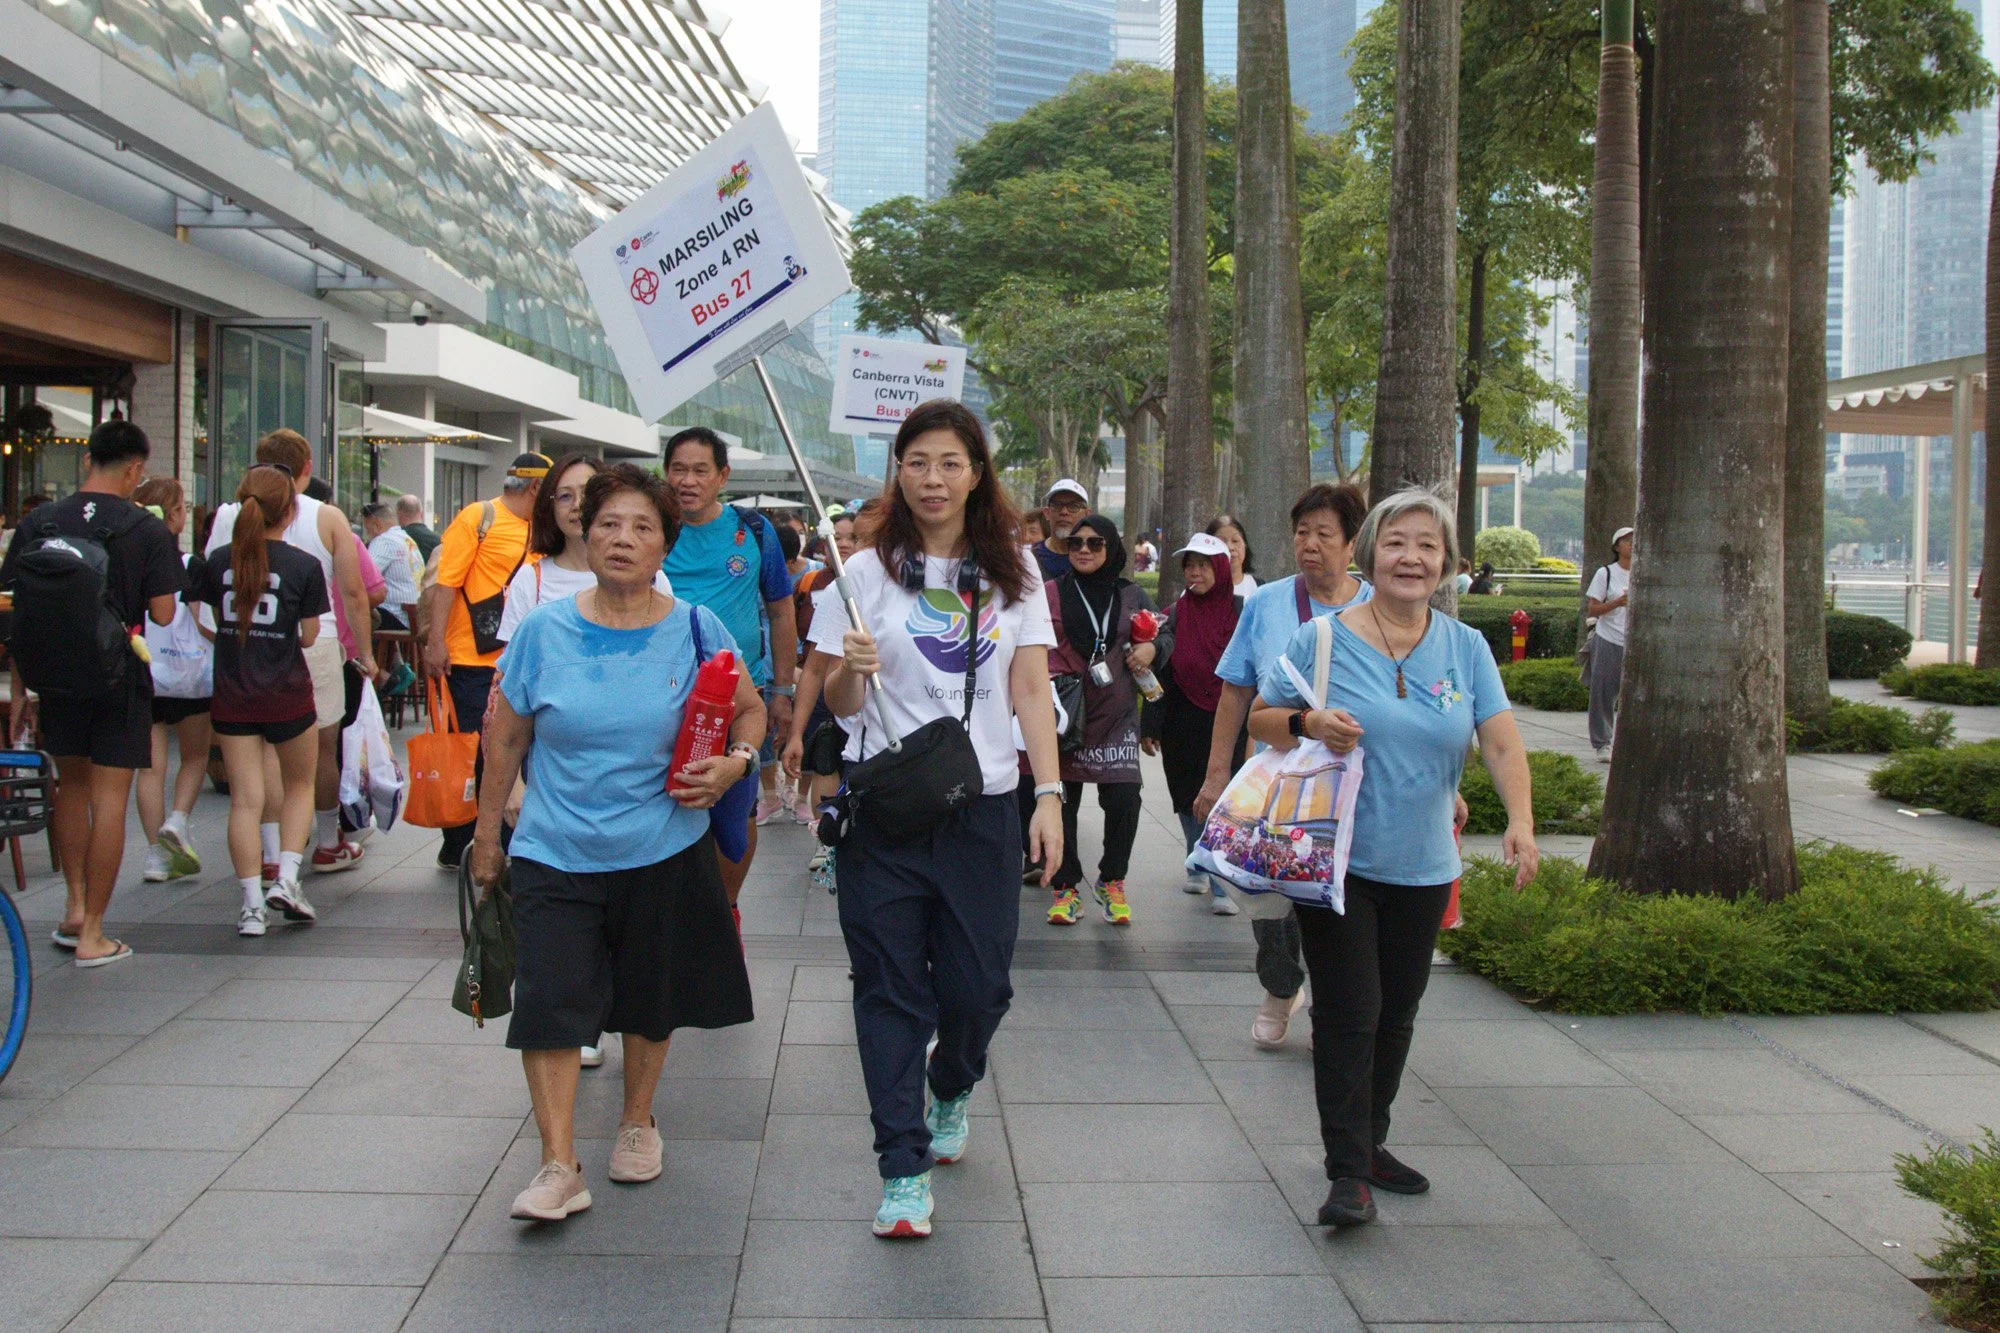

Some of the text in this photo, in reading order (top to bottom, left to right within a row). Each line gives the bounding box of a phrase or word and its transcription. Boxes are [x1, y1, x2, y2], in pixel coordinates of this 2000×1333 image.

[658, 198, 754, 275] MARSILING
[675, 228, 761, 300] Zone 4 RN
[691, 292, 730, 326] Bus
[731, 269, 753, 299] 27
[852, 368, 945, 388] Canberra Vista
[874, 387, 919, 404] (CNVT)
[876, 404, 901, 417] Bus
[924, 685, 992, 700] Vouner
